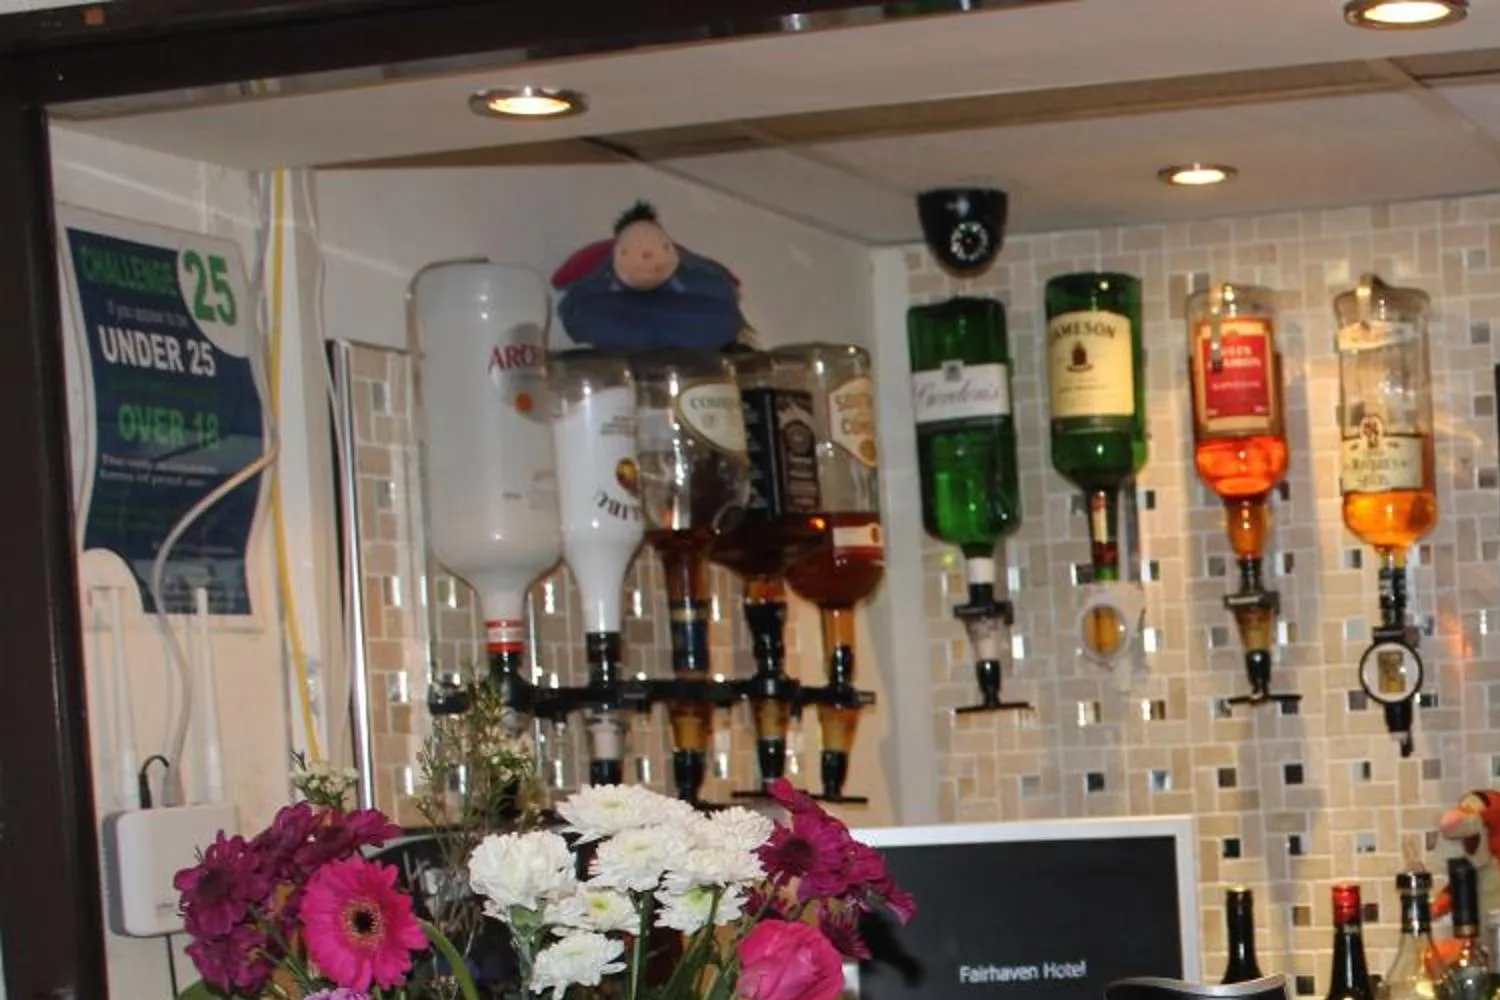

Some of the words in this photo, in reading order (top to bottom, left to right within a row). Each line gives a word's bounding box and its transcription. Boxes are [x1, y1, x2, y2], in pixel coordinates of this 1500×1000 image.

[184, 250, 237, 326] 25
[98, 324, 184, 373] UNDER
[187, 337, 216, 377] 25
[1052, 321, 1117, 340] AMESON
[117, 403, 187, 446] OVER
[193, 412, 221, 449] 18
[959, 963, 1039, 984] Fairhaven
[1042, 959, 1087, 980] Hotel
